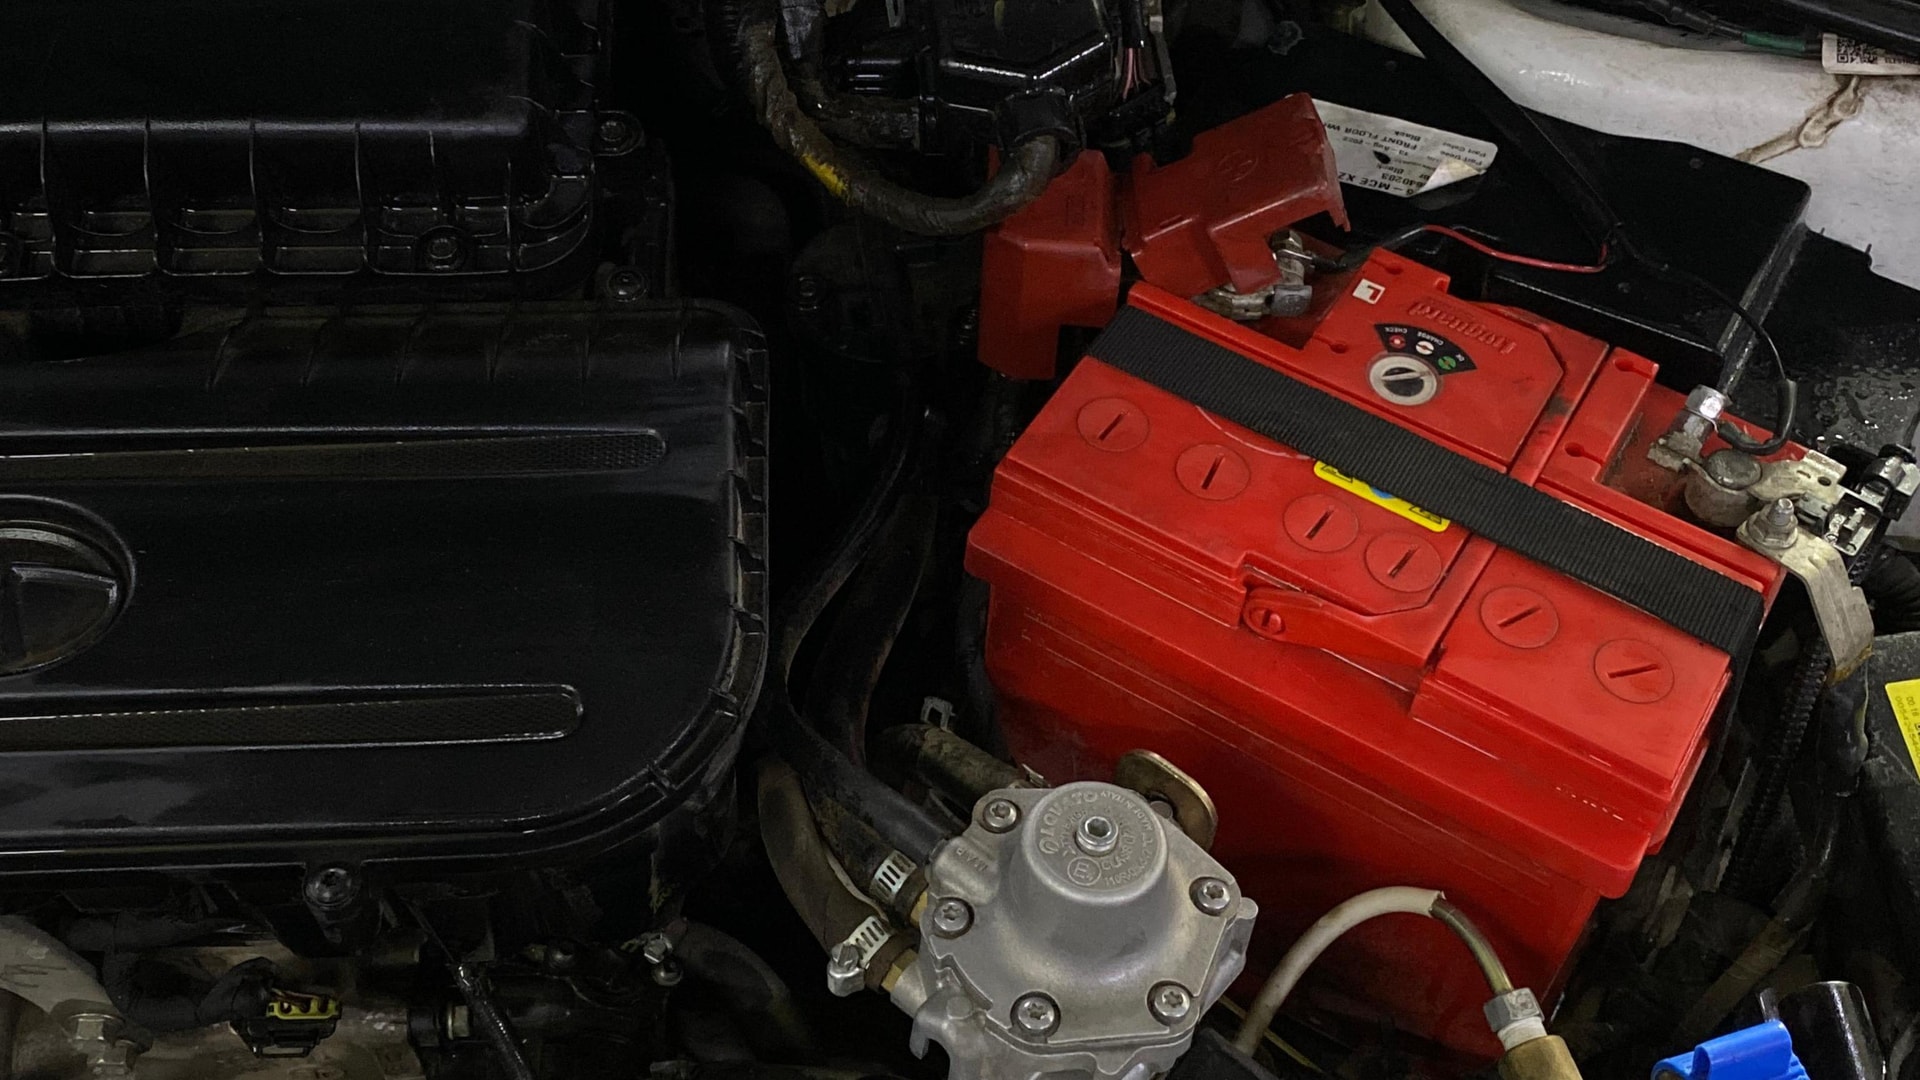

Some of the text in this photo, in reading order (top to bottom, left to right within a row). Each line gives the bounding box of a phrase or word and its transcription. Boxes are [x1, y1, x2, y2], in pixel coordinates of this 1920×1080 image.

[1394, 130, 1422, 142] Black
[1361, 179, 1391, 191] MCE
[1417, 331, 1444, 346] CHARGE
[1455, 353, 1465, 362] OK
[1100, 791, 1124, 803] ITALY
